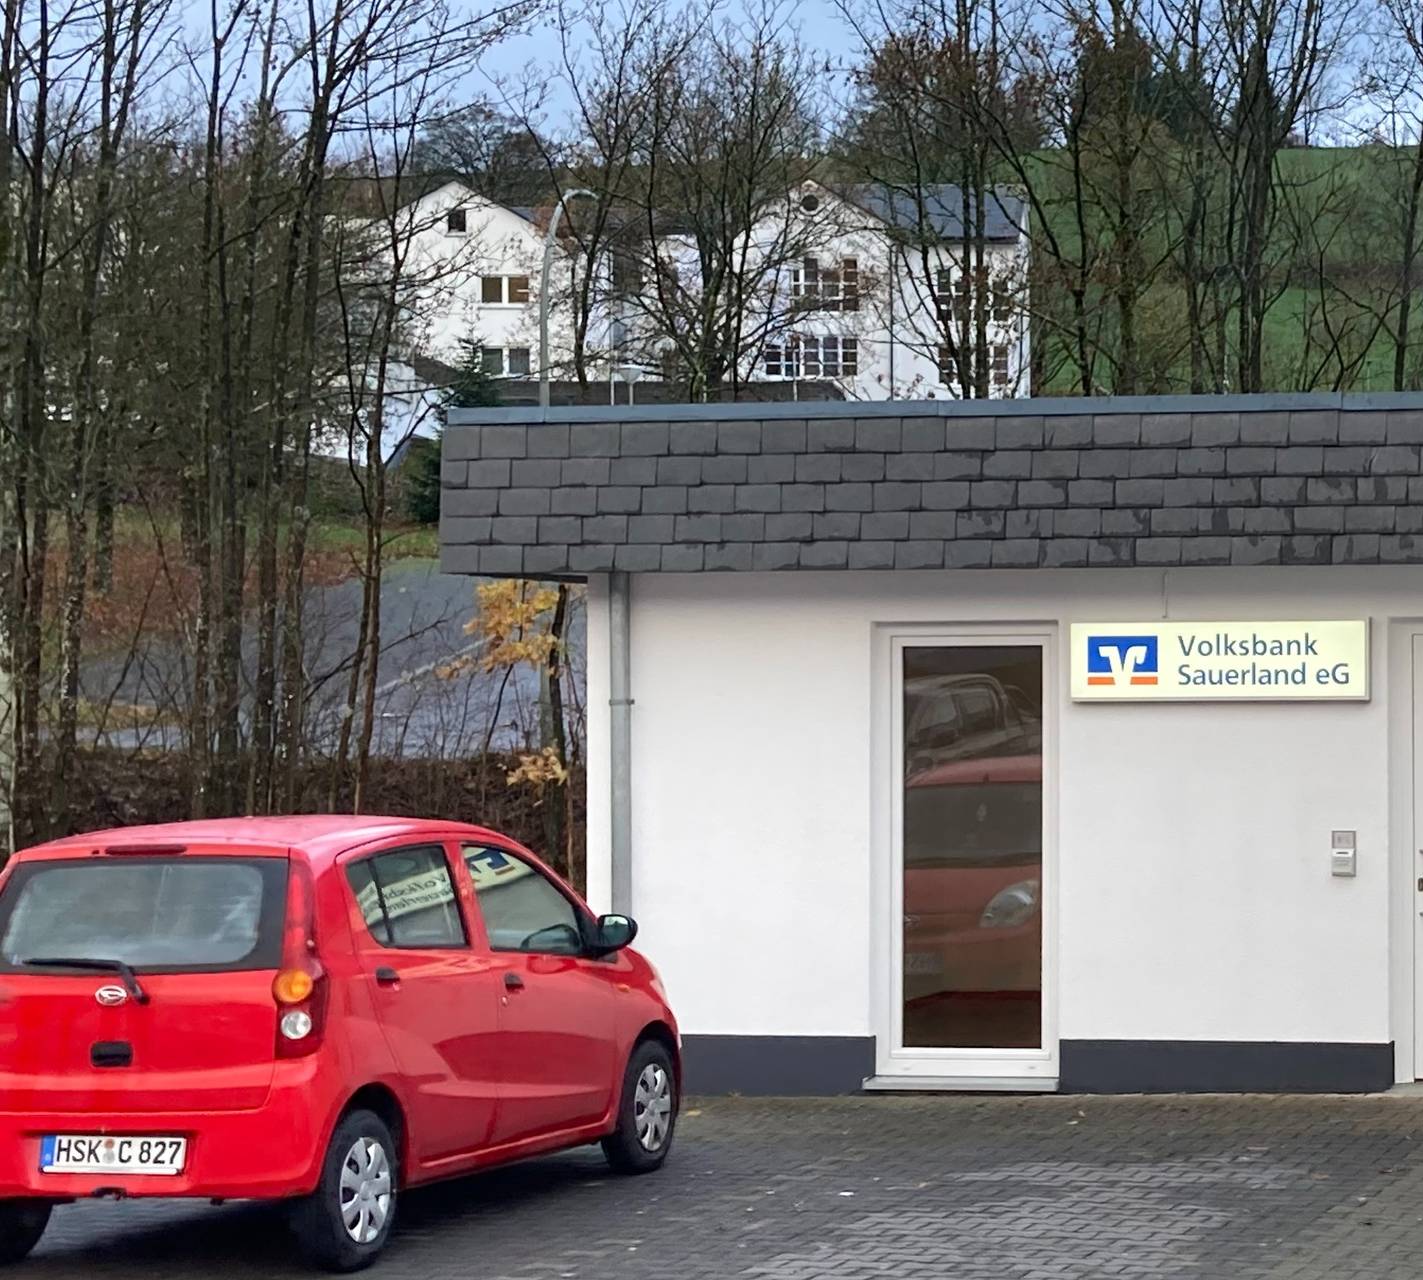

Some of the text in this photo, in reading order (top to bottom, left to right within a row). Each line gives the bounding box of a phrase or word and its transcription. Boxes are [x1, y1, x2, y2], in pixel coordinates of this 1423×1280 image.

[1177, 632, 1319, 657] Volksbank
[1177, 661, 1351, 686] Sauerland eG
[56, 1139, 182, 1165] HSK C 827
